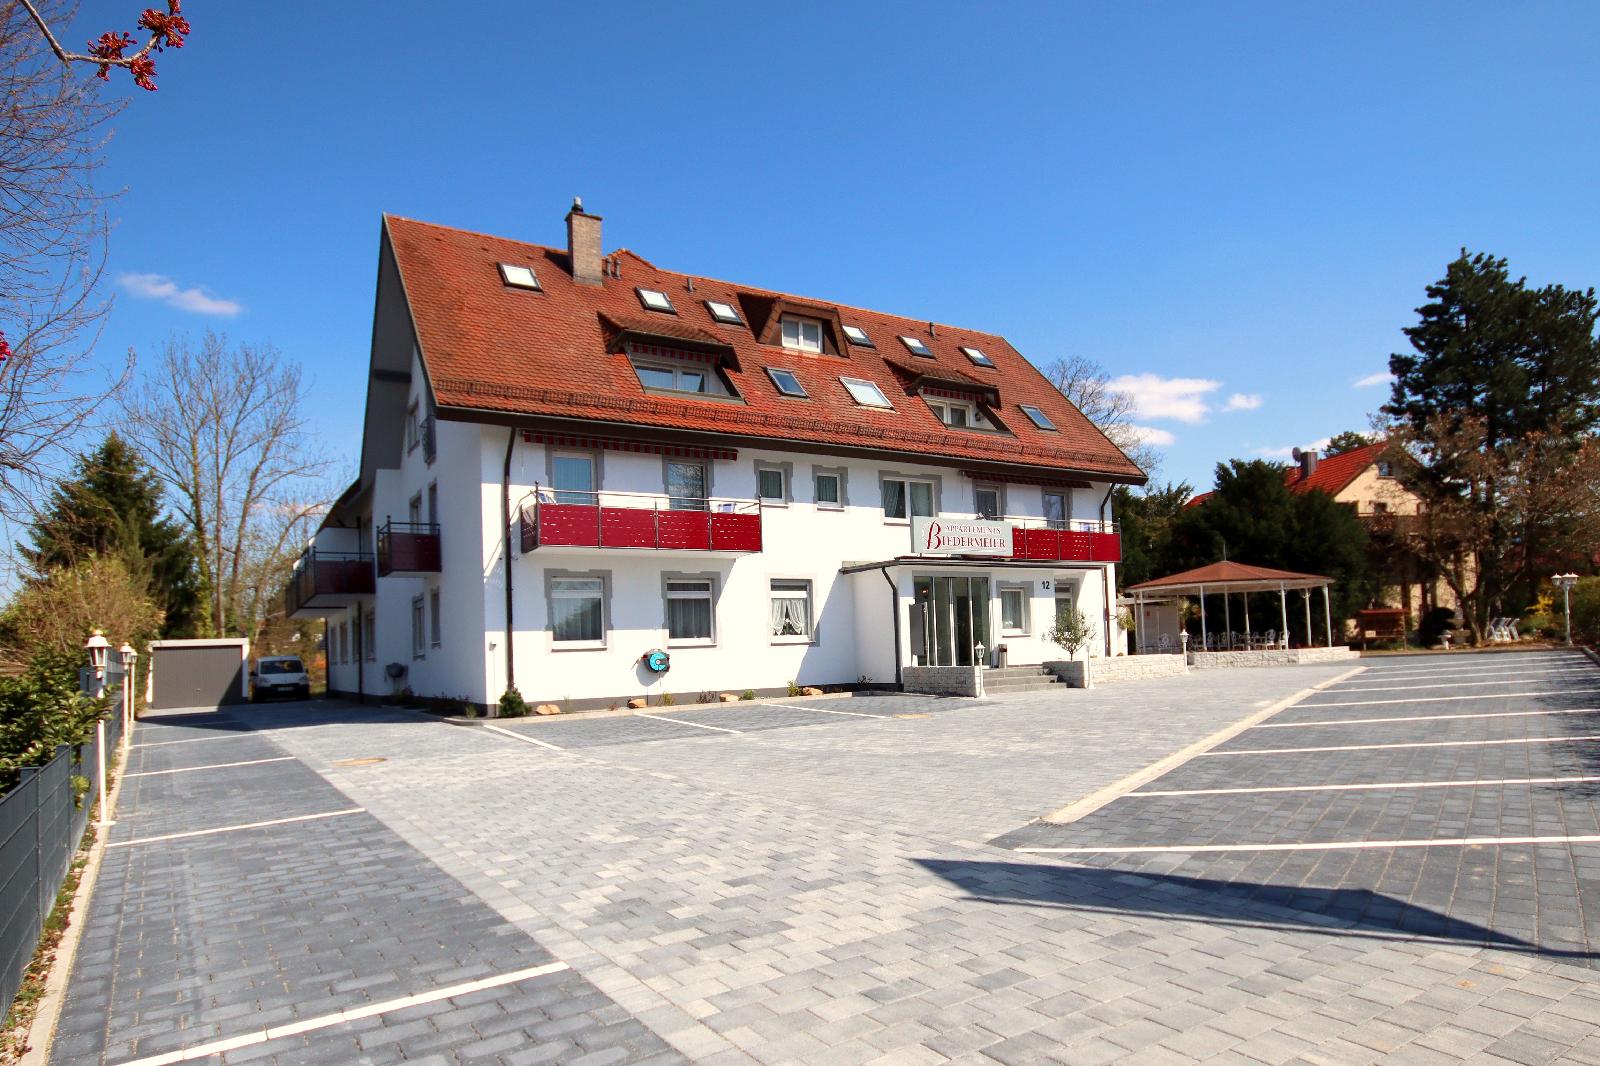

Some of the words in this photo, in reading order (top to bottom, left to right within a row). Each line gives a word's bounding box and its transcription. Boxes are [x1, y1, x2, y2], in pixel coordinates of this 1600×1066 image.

[926, 520, 1006, 549] BIEDERMEIER
[946, 525, 1001, 535] APPARTEMENTS
[1042, 581, 1050, 590] 12
